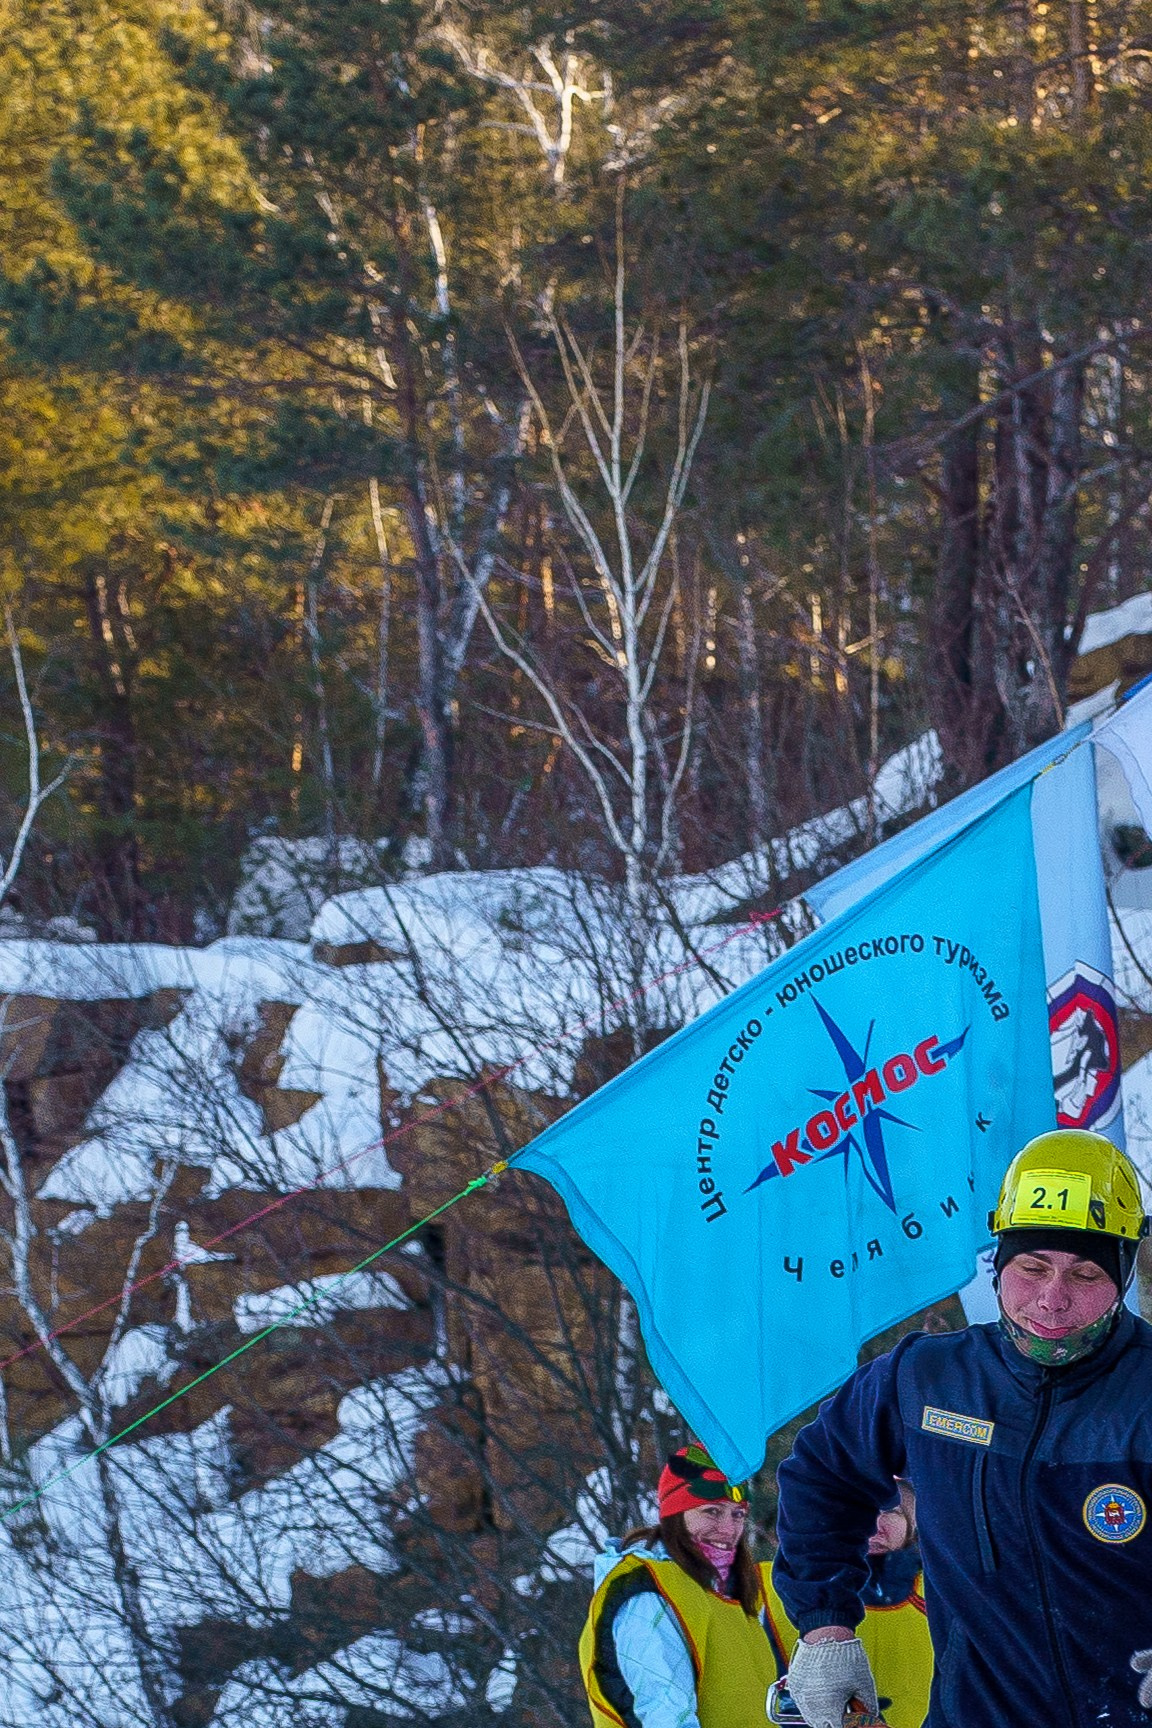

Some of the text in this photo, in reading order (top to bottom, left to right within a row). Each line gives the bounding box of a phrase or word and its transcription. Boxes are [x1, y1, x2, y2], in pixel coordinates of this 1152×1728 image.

[775, 932, 925, 1009] юношеского
[932, 935, 1010, 1022] туризма
[706, 1018, 763, 1115] детско
[770, 1034, 947, 1178] КОСМОС
[696, 1117, 729, 1223] Центр
[1030, 1187, 1069, 1211] 2.1
